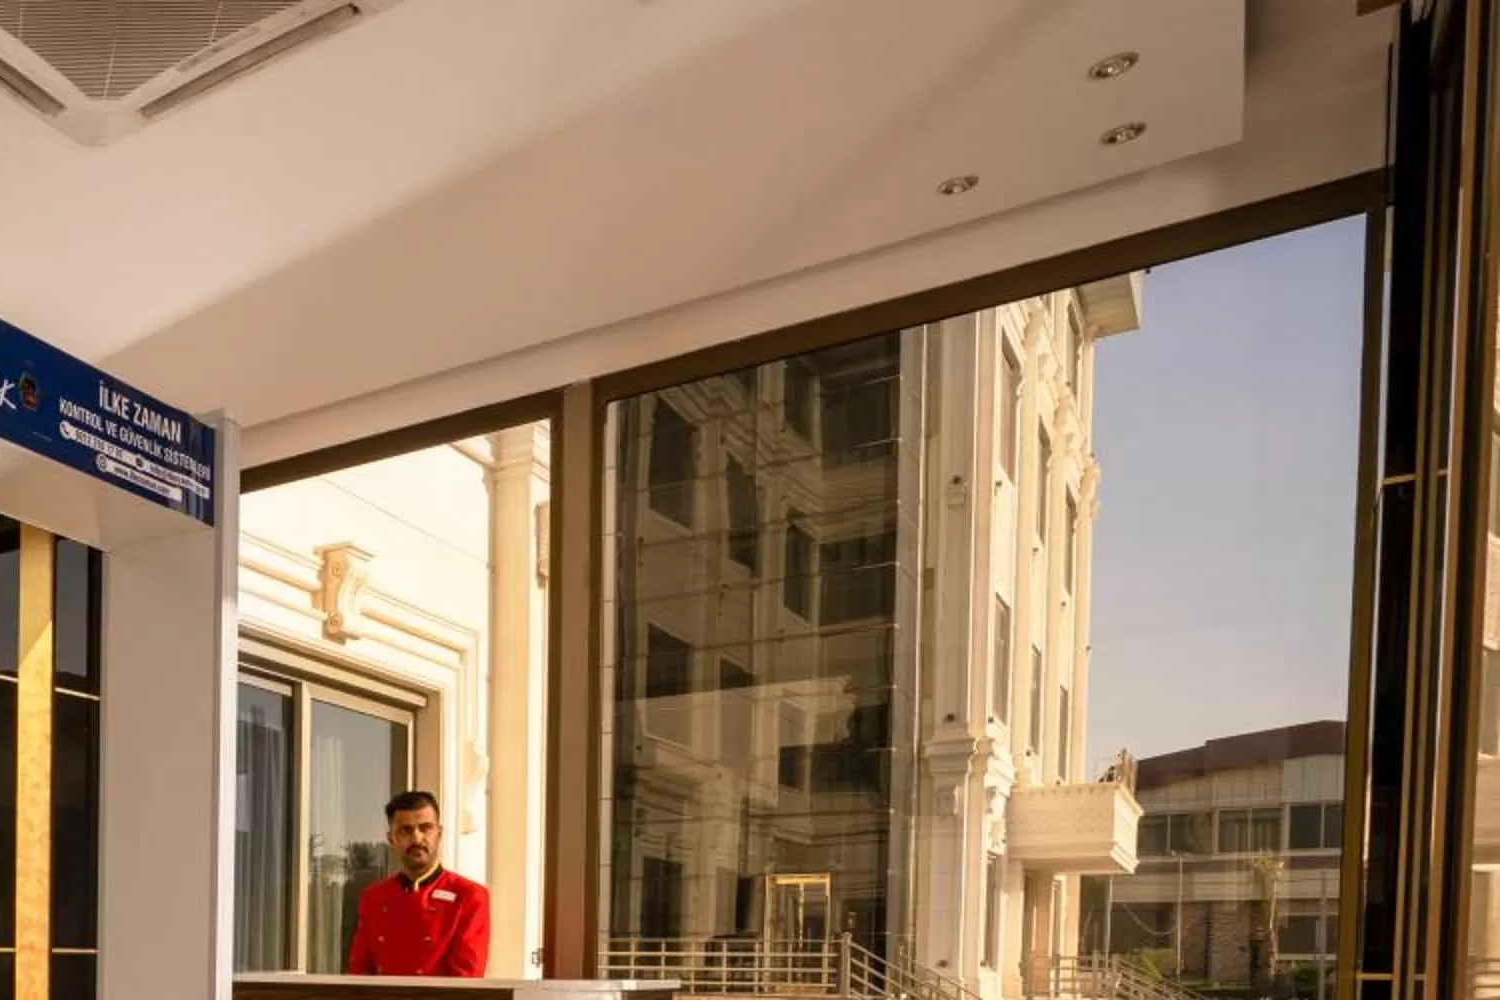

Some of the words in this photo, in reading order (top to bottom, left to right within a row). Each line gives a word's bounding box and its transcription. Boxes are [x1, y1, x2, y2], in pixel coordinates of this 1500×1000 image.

[59, 396, 102, 431] KONTROL
[105, 420, 118, 439] VE
[99, 380, 130, 420] İLKE
[133, 402, 182, 444] ZAMAN
